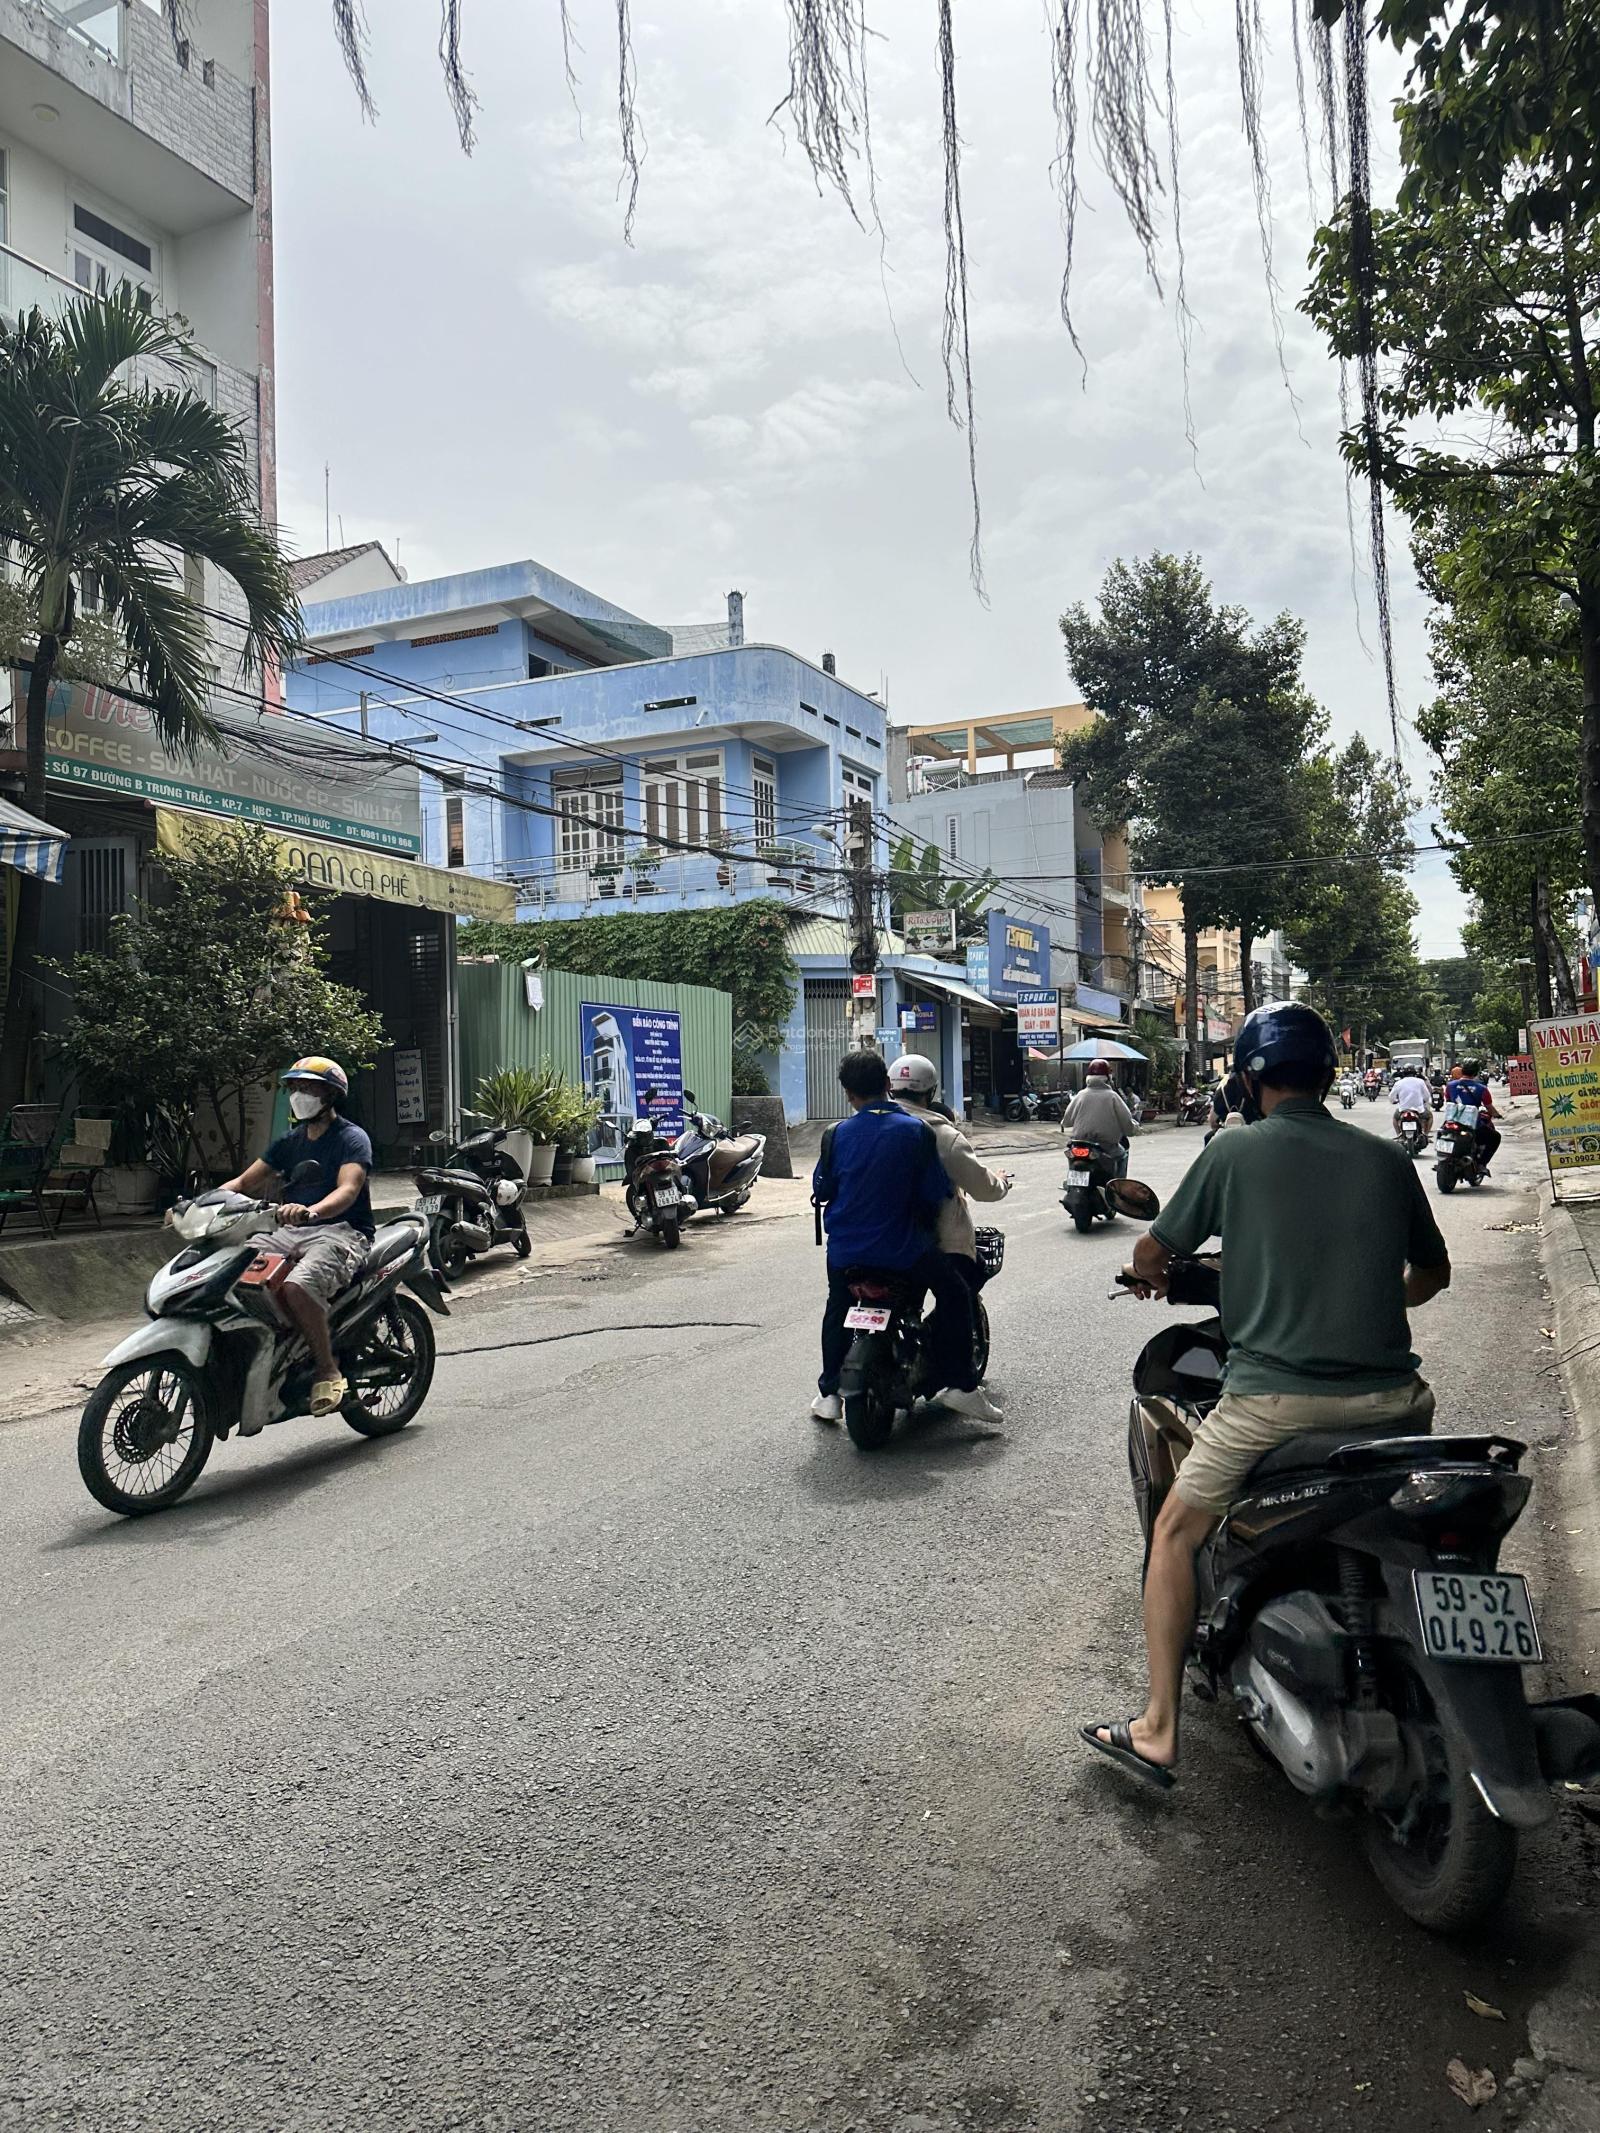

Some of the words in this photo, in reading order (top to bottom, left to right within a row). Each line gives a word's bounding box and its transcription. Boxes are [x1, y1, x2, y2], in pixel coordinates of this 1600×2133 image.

[45, 725, 132, 765] COFFEE
[343, 799, 379, 822] SINH
[382, 804, 402, 826] TỐ
[52, 761, 69, 775] SỐ
[73, 766, 87, 779] 97
[91, 769, 132, 788] ĐƯỜNG
[146, 781, 182, 799] TRƯNG
[185, 786, 212, 805] TRẮC
[222, 797, 242, 811] KP.7
[252, 804, 272, 817] HBC
[281, 811, 310, 827] TP.THỦ
[312, 816, 331, 830] ĐỨC
[346, 824, 359, 837] ĐT:
[361, 828, 380, 841] 0981
[350, 865, 374, 891] CÀ
[381, 873, 410, 898] PHÊ
[653, 1016, 666, 1030] CÔNG
[1536, 1027, 1572, 1049] VĂN
[1577, 1021, 1600, 1045] LẬ
[1559, 1050, 1592, 1066] 517
[1542, 1072, 1554, 1088] LẨU
[1555, 1074, 1564, 1086] CÁ
[1581, 1068, 1598, 1084] HỒNG
[1578, 1087, 1589, 1097] GÀ
[1575, 1154, 1595, 1162] 0902
[1432, 1576, 1515, 1616] 59-S2
[1429, 1615, 1533, 1657] 049.26
